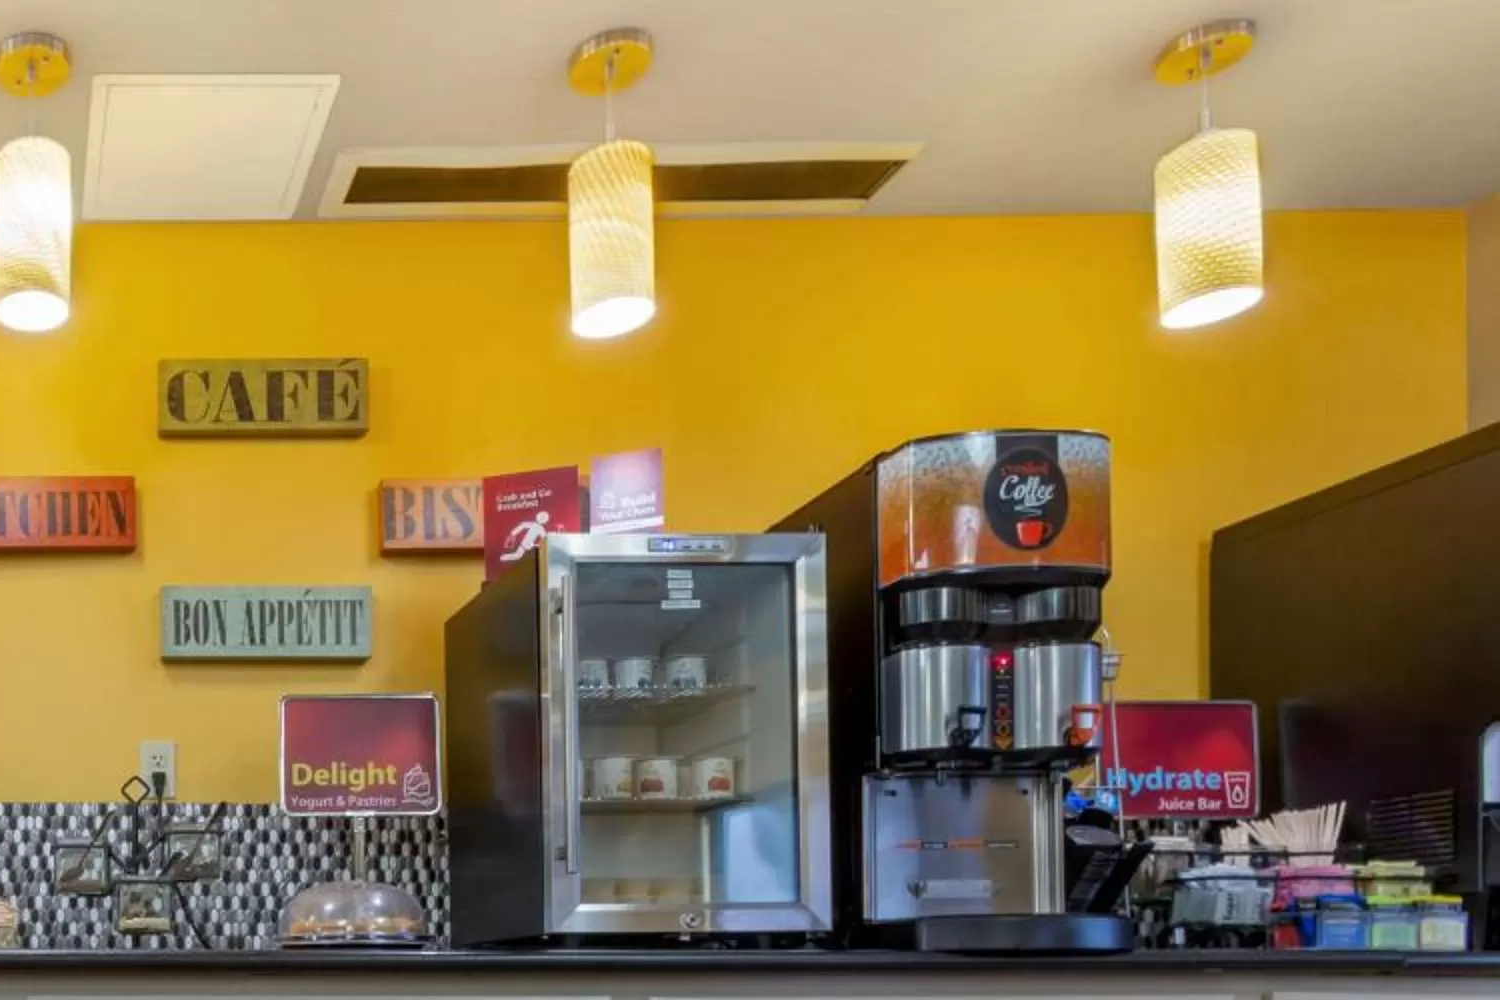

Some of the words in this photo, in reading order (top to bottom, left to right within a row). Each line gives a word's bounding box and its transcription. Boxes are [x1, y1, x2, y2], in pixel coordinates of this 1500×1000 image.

[166, 358, 360, 424] CAFÉ
[999, 474, 1056, 506] Coffee
[172, 597, 228, 646] BON
[239, 588, 364, 647] APPÉTIT
[291, 761, 397, 792] Delight
[1105, 765, 1222, 797] Hydrate
[290, 795, 333, 811] Yogurt
[335, 795, 346, 808] &
[1157, 797, 1195, 811] Juice
[1197, 797, 1221, 811] Bar
